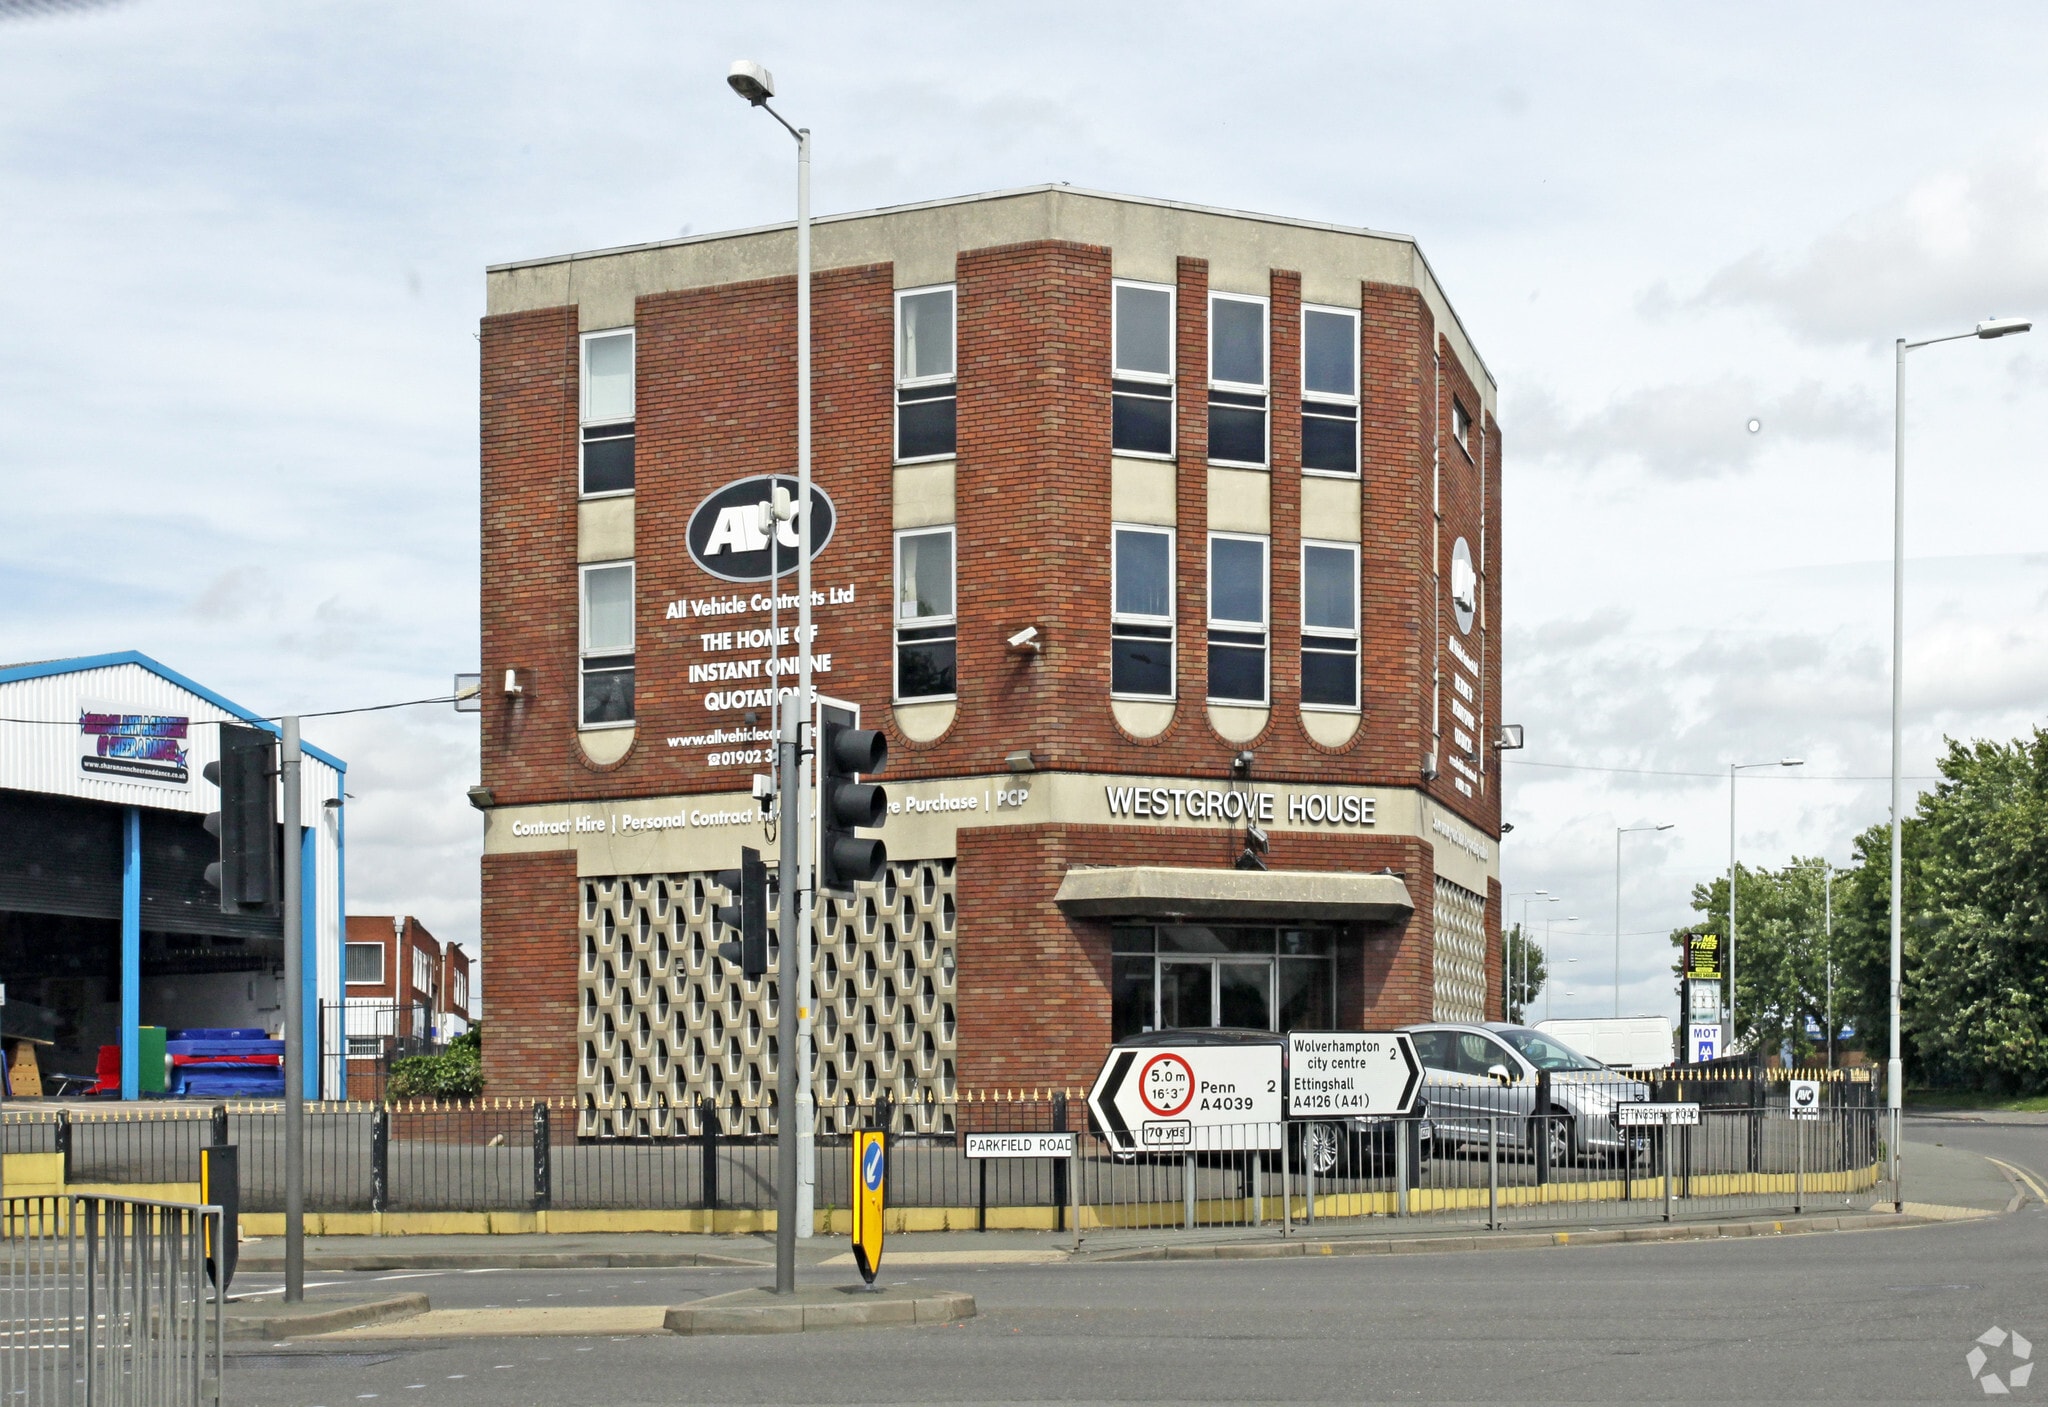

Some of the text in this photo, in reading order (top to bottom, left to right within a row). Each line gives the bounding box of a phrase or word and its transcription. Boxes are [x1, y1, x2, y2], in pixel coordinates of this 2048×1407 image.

[666, 584, 855, 619] All Vehicle Contrats Ltd
[701, 632, 731, 652] THE
[737, 627, 789, 649] HOME
[689, 654, 832, 683] INSTANT ONLNE
[120, 715, 143, 736] ANN
[109, 737, 137, 758] CHEER
[137, 738, 145, 759] &
[145, 738, 178, 761] DANCE
[722, 749, 762, 766] 01902
[905, 793, 978, 813] Purchase
[997, 789, 1029, 807] PCP
[1105, 786, 1377, 824] WESTGROVE HOUSE
[512, 818, 571, 837] Contract
[575, 815, 605, 833] Hire
[622, 810, 686, 831] Personal
[690, 808, 753, 828] Contract
[1690, 942, 1718, 950] TYRES
[1693, 1028, 1718, 1039] MOT
[1293, 1039, 1397, 1060] Wolverhampton 2
[1307, 1056, 1366, 1070] city centre
[1151, 1069, 1186, 1082] 5.0 m
[1200, 1080, 1277, 1094] Penn 2
[1294, 1077, 1354, 1093] Ettingshall
[1294, 1094, 1370, 1110] A4126 (A41)
[1797, 1089, 1812, 1101] AVC
[1200, 1097, 1253, 1111] A4039
[1675, 1107, 1698, 1120] ROAD
[1148, 1126, 1185, 1139] 70 yds
[969, 1138, 1072, 1151] PARKFIELD ROAD
